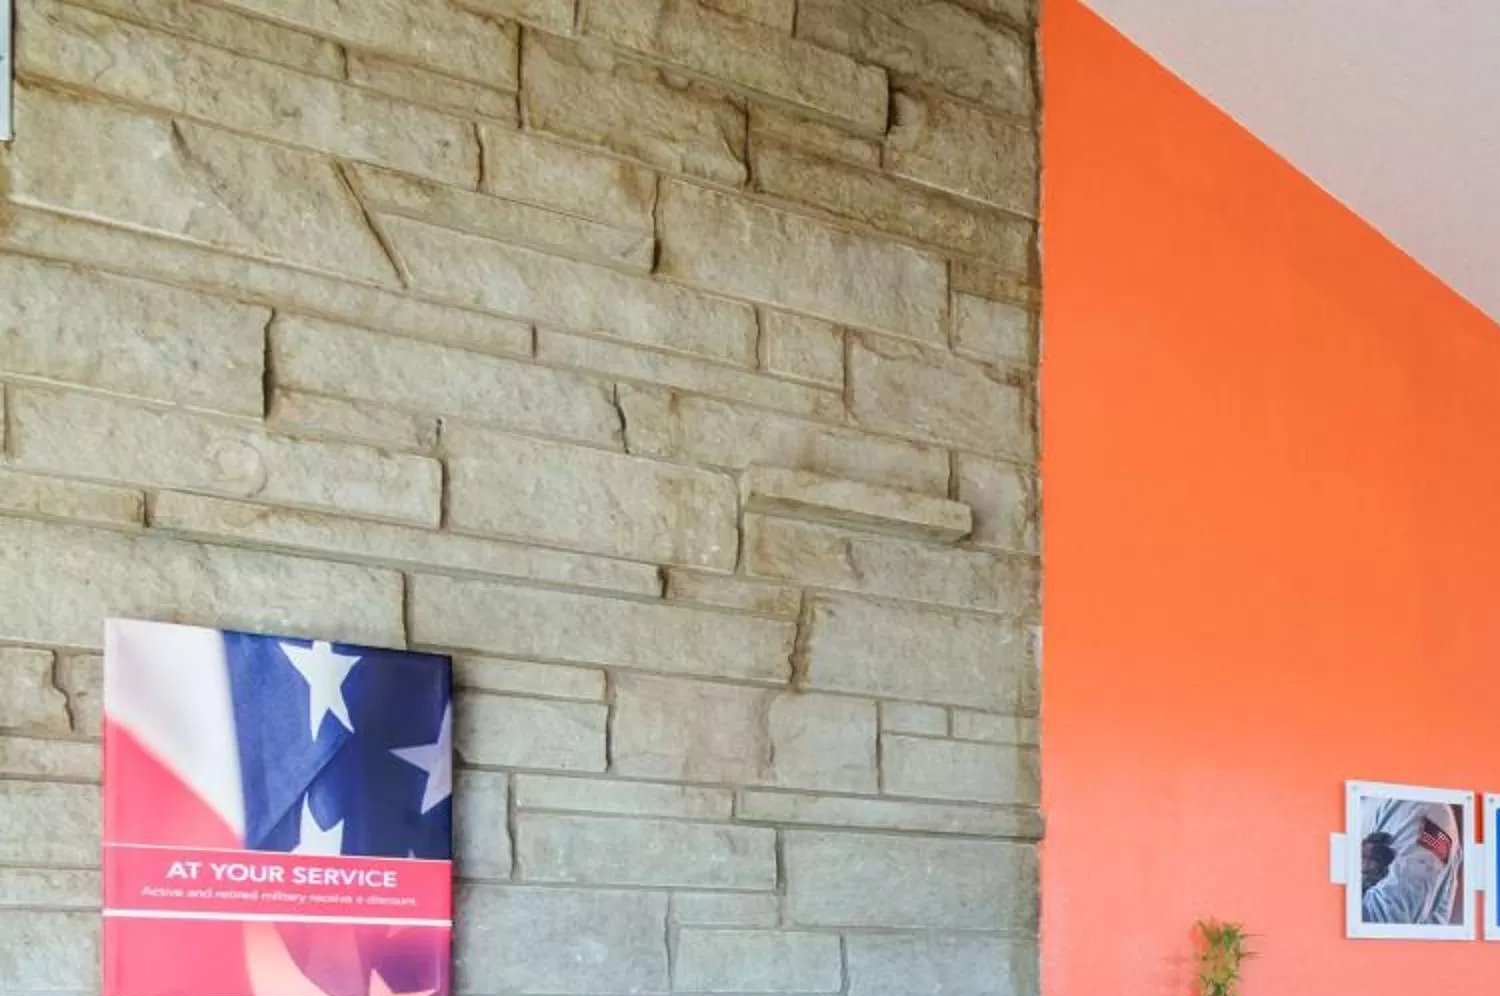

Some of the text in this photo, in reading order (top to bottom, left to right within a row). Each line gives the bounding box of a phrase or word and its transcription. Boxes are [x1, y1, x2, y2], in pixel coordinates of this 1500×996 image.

[166, 861, 398, 888] AT YOUR SERVICE
[141, 885, 184, 897] Active
[187, 887, 212, 898] and
